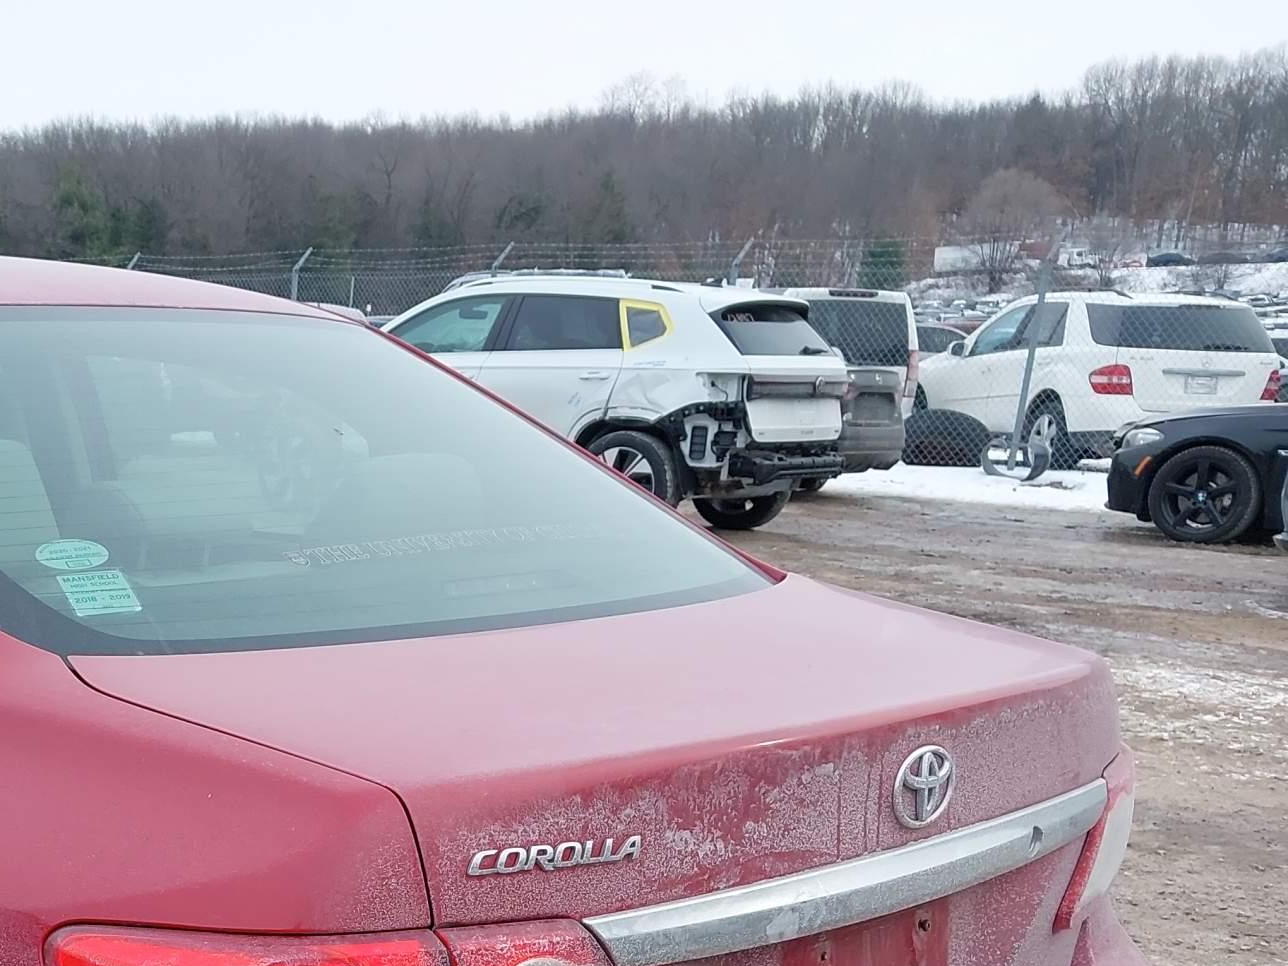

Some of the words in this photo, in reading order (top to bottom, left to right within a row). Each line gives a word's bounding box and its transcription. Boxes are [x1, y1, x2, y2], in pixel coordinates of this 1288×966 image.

[62, 574, 119, 583] MANSFIELD
[108, 594, 131, 602] 2019
[467, 835, 642, 876] COROLLA
